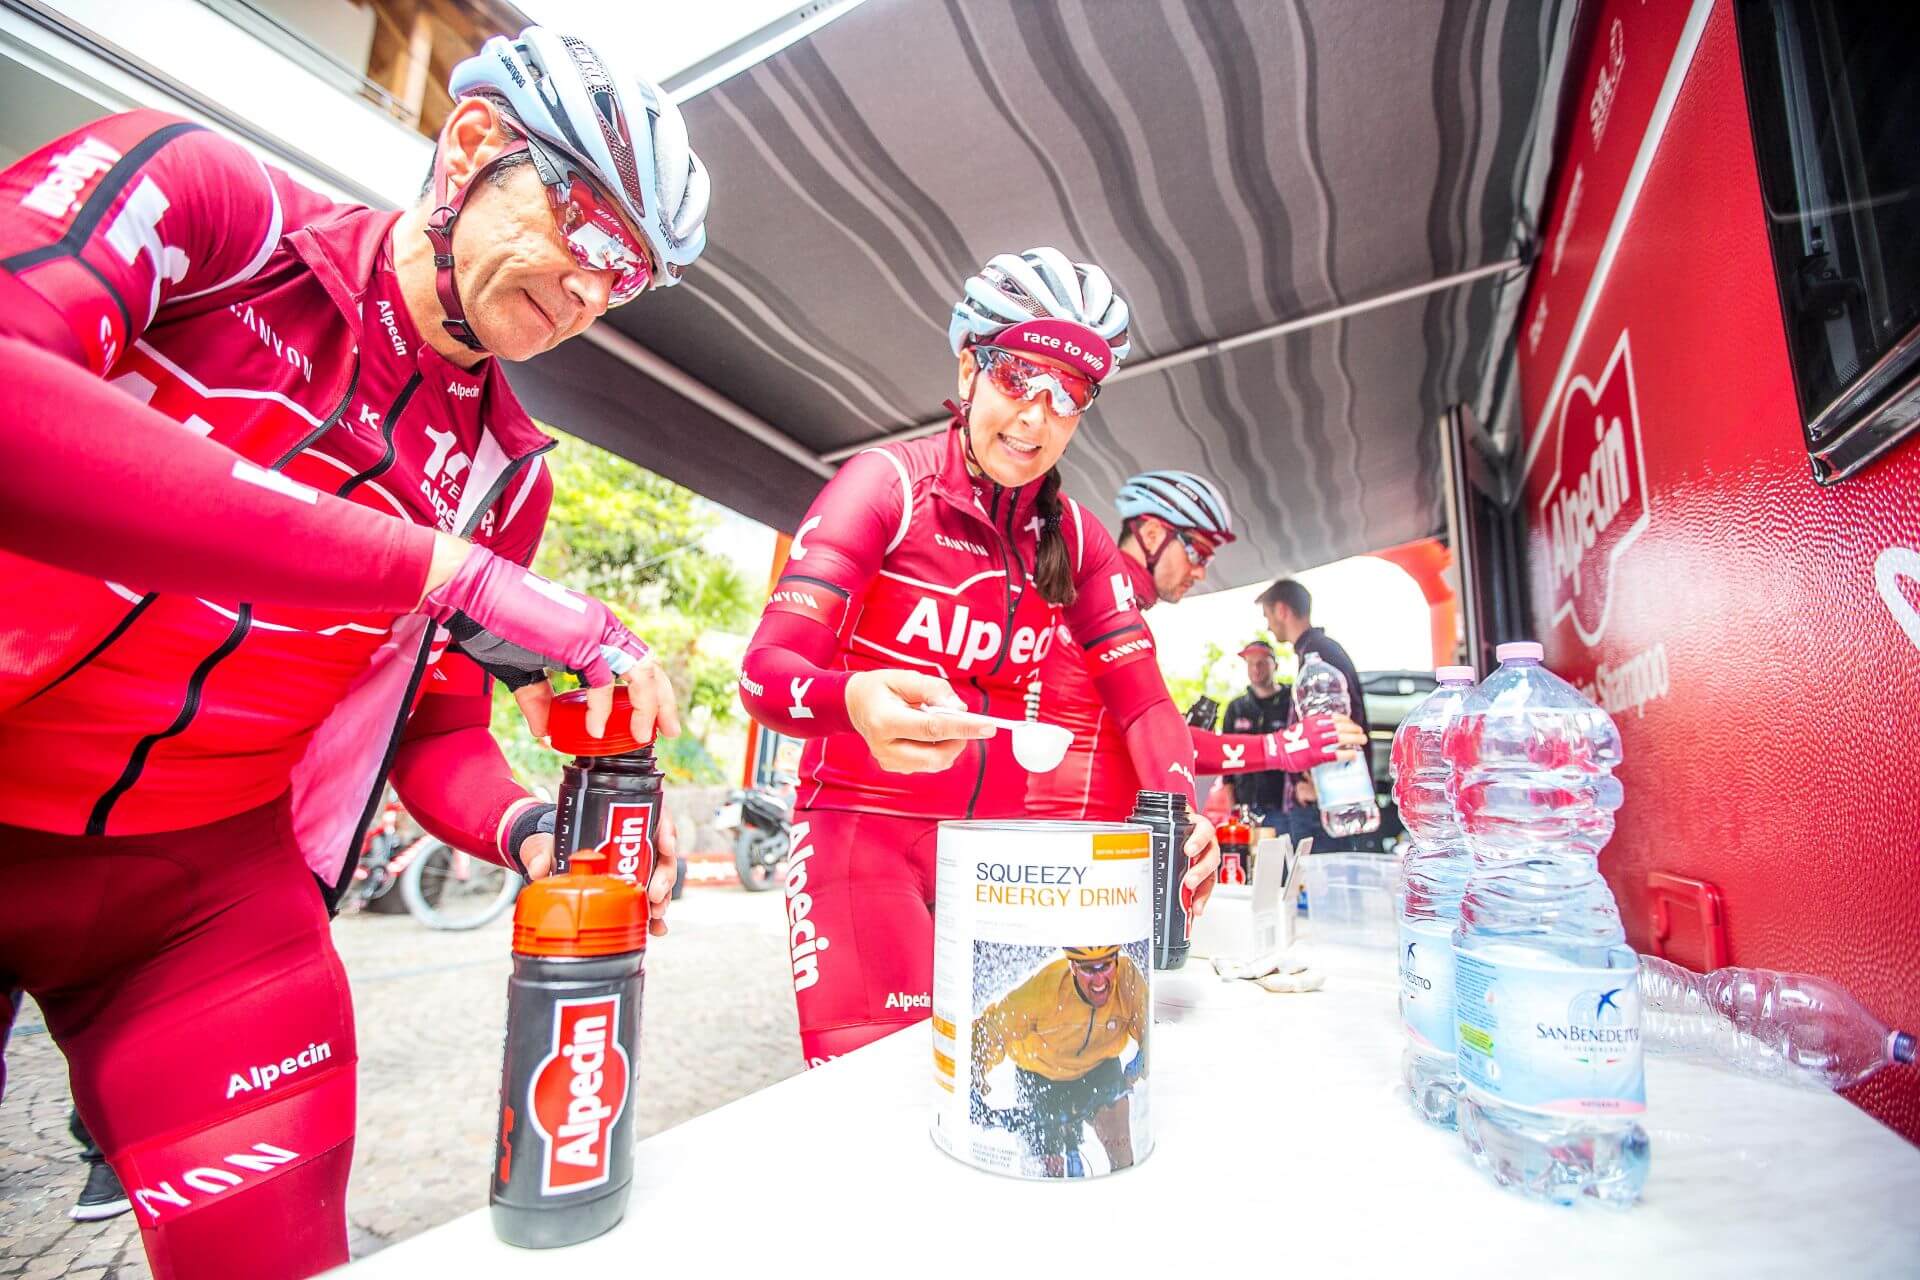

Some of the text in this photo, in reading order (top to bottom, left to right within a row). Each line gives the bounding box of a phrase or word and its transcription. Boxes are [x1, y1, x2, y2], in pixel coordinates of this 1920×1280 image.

[377, 300, 407, 356] Alpecin
[1023, 330, 1105, 372] race to win
[1551, 415, 1631, 594] Alpecin
[767, 591, 818, 609] ANYON
[976, 862, 1087, 885] SQUEEZY
[976, 884, 1138, 907] ENERGY DRINK
[785, 820, 830, 993] Alpecin
[226, 1041, 332, 1100] Alpecin
[556, 1014, 612, 1168] Alpecin
